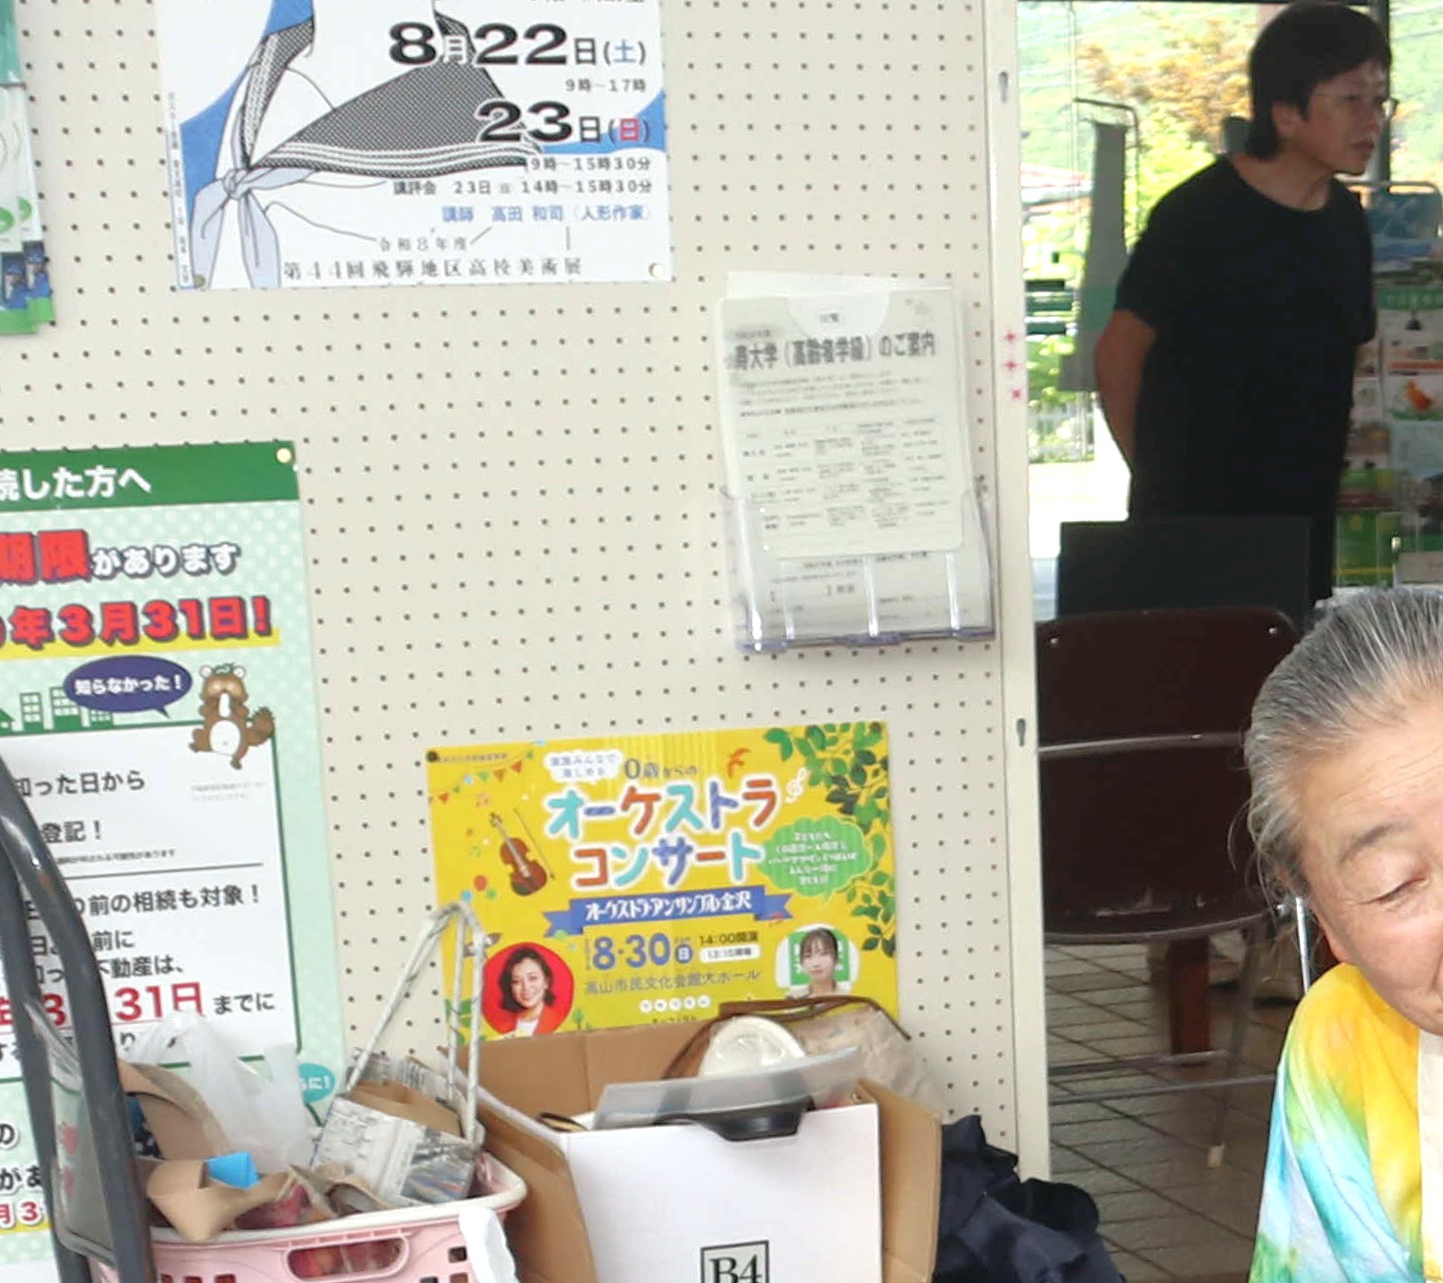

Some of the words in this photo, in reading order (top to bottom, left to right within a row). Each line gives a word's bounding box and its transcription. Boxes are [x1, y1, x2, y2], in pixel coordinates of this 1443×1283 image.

[546, 777, 777, 838] オーケストラ
[573, 832, 763, 888] コンサート
[213, 990, 276, 1016] までに
